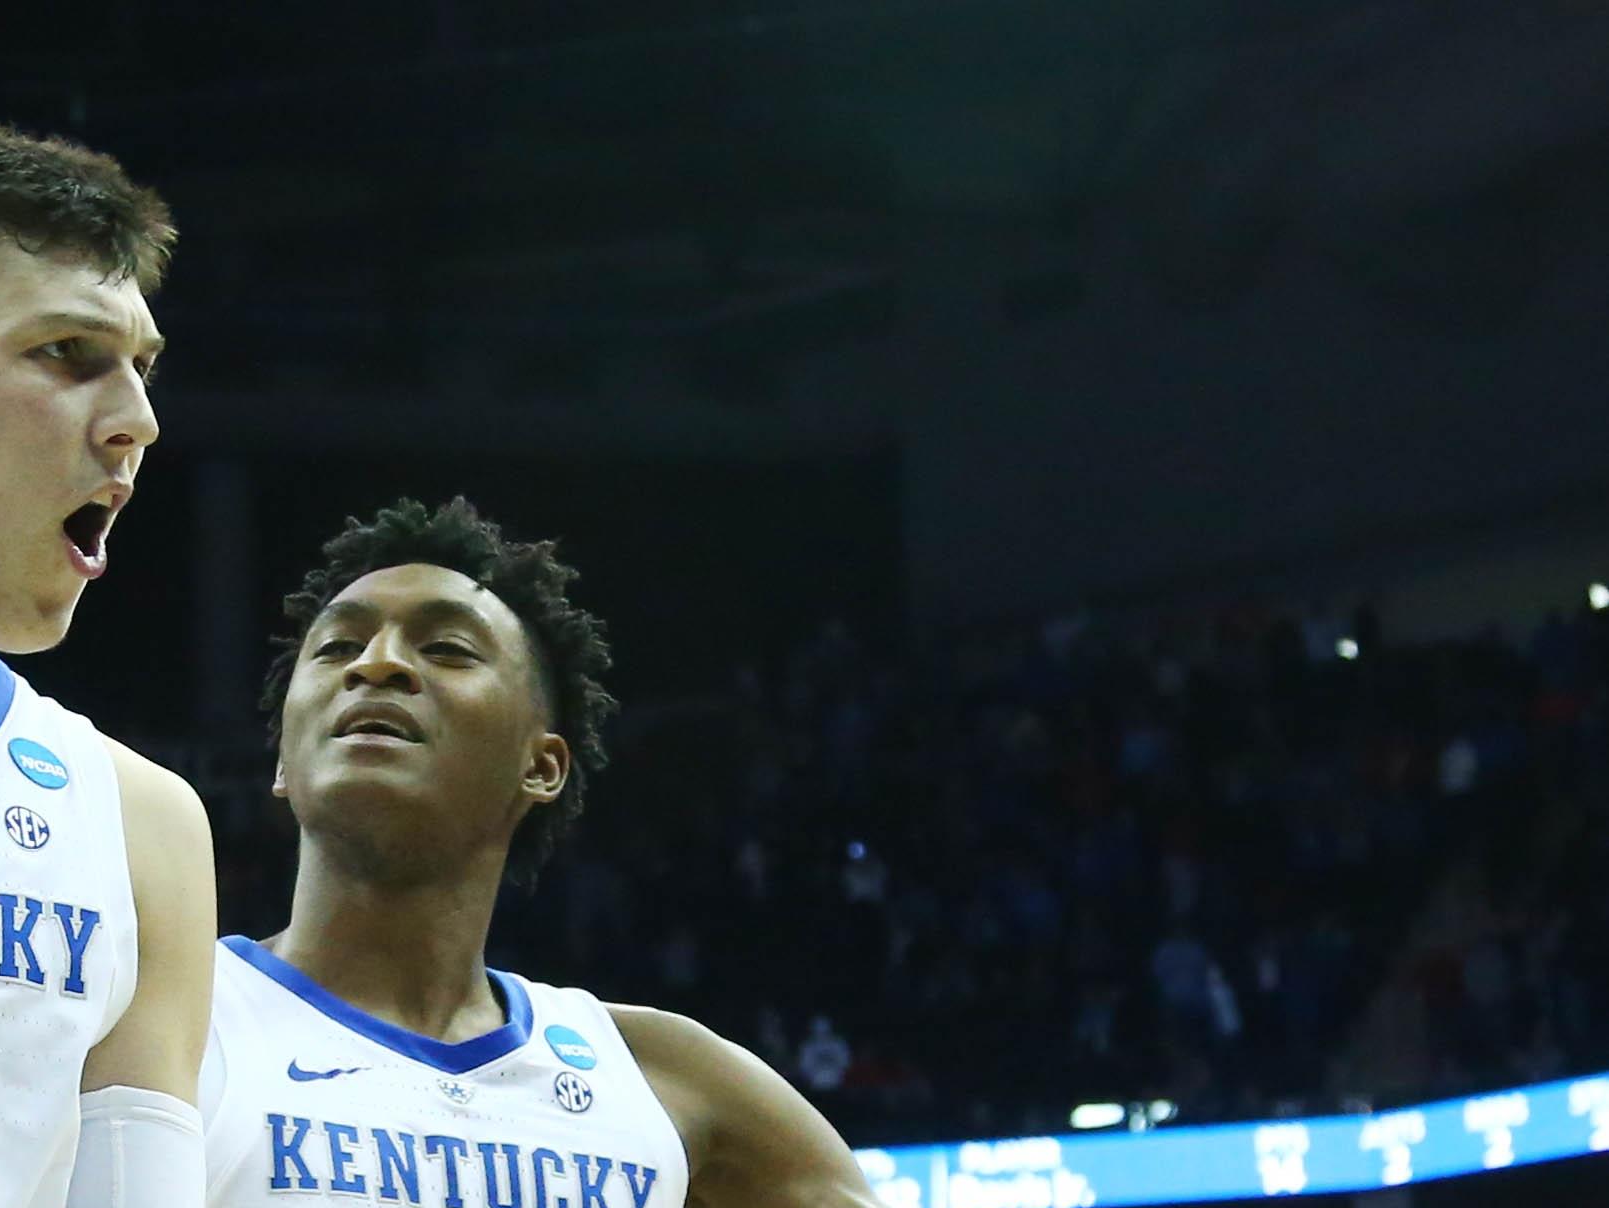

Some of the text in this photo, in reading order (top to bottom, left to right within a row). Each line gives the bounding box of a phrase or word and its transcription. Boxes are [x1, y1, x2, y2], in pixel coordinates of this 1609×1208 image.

[19, 754, 69, 780] NCAA
[5, 806, 50, 849] SEC
[555, 1072, 593, 1113] SEC
